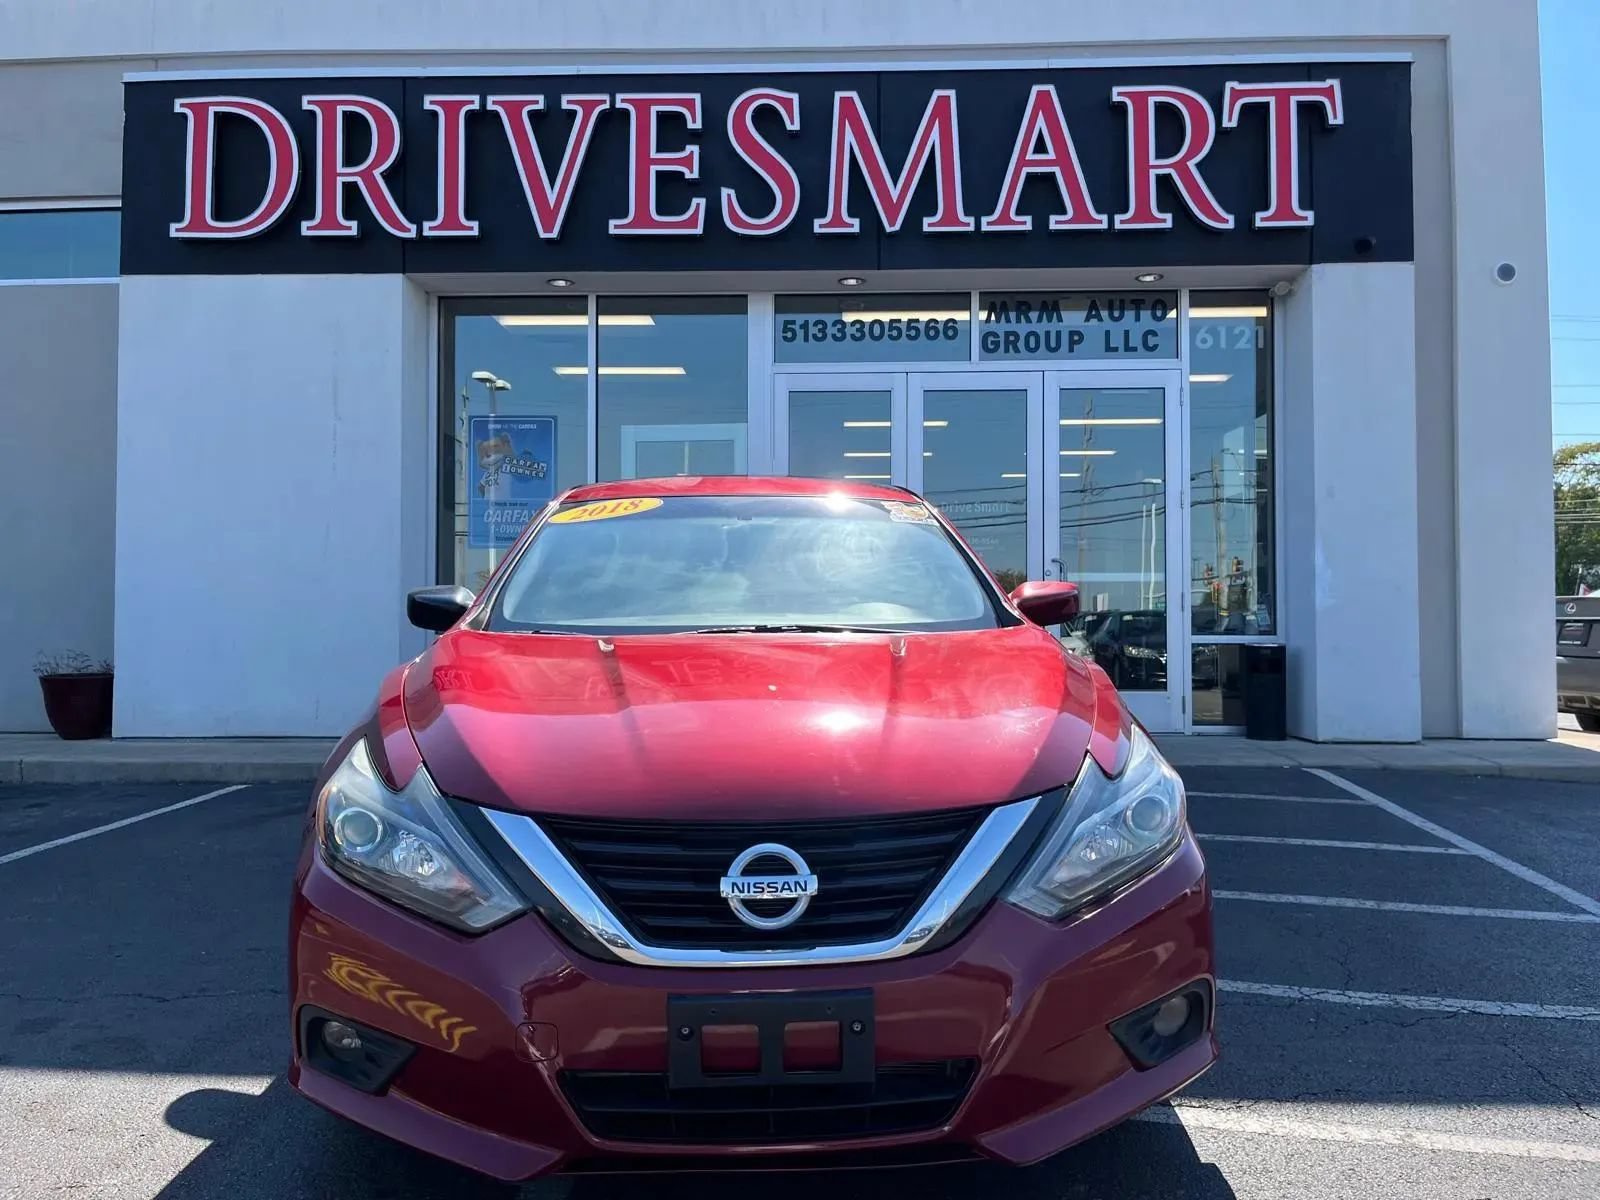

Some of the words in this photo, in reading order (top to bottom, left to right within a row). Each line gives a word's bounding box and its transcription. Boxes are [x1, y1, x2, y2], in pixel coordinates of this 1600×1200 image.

[169, 80, 1345, 241] DRIVESMART
[984, 300, 1064, 325] MRM
[1083, 298, 1168, 323] AUTO
[781, 317, 959, 343] 5133305566
[981, 329, 1085, 354] GROUP
[1104, 329, 1160, 353] LLC
[1195, 325, 1265, 350] 6121
[568, 500, 643, 521] 2018
[942, 502, 972, 513] Drive
[974, 502, 1010, 513] Smart
[731, 880, 808, 894] NISSAN
